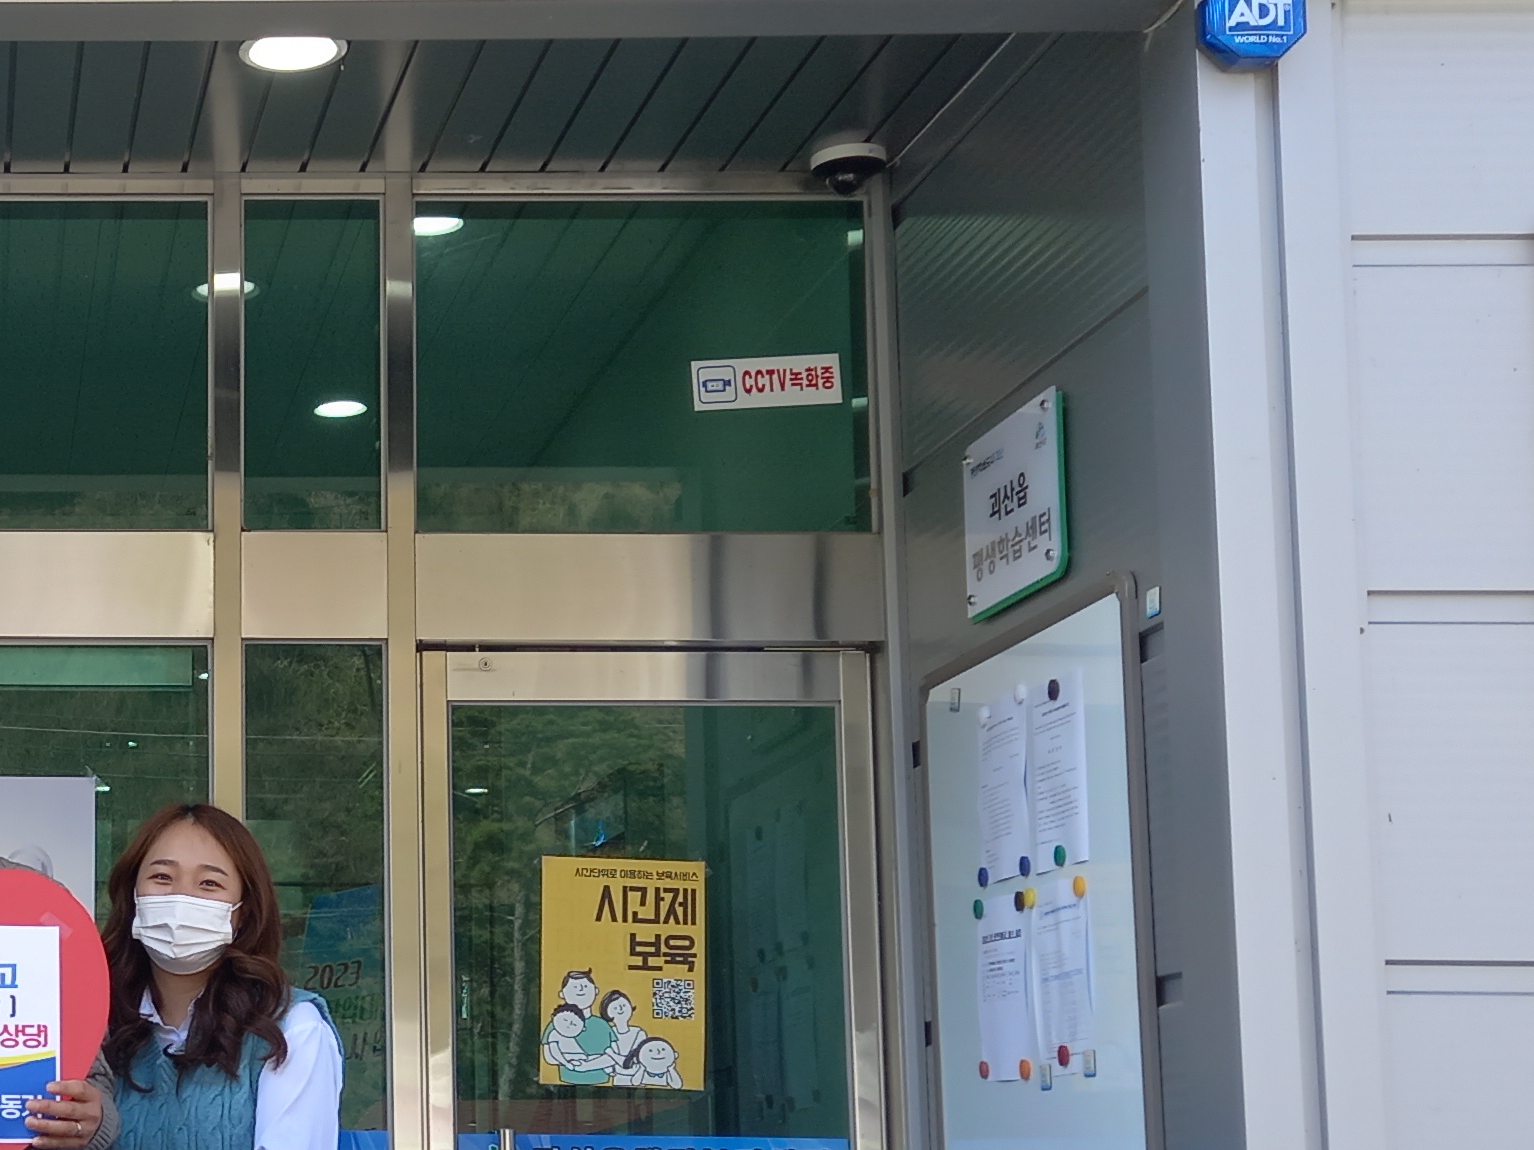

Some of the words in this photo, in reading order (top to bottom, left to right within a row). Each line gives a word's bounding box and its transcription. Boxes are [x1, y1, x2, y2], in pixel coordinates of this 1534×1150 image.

[742, 365, 835, 395] CCTV녹화중
[989, 471, 1029, 520] 괴산읍
[972, 507, 1052, 582] 평생학습센터
[620, 869, 654, 880] 이용하는
[656, 870, 699, 881] 보육서비스
[595, 885, 697, 926] 시간제
[628, 932, 697, 972] 보육
[303, 960, 362, 990] 2023
